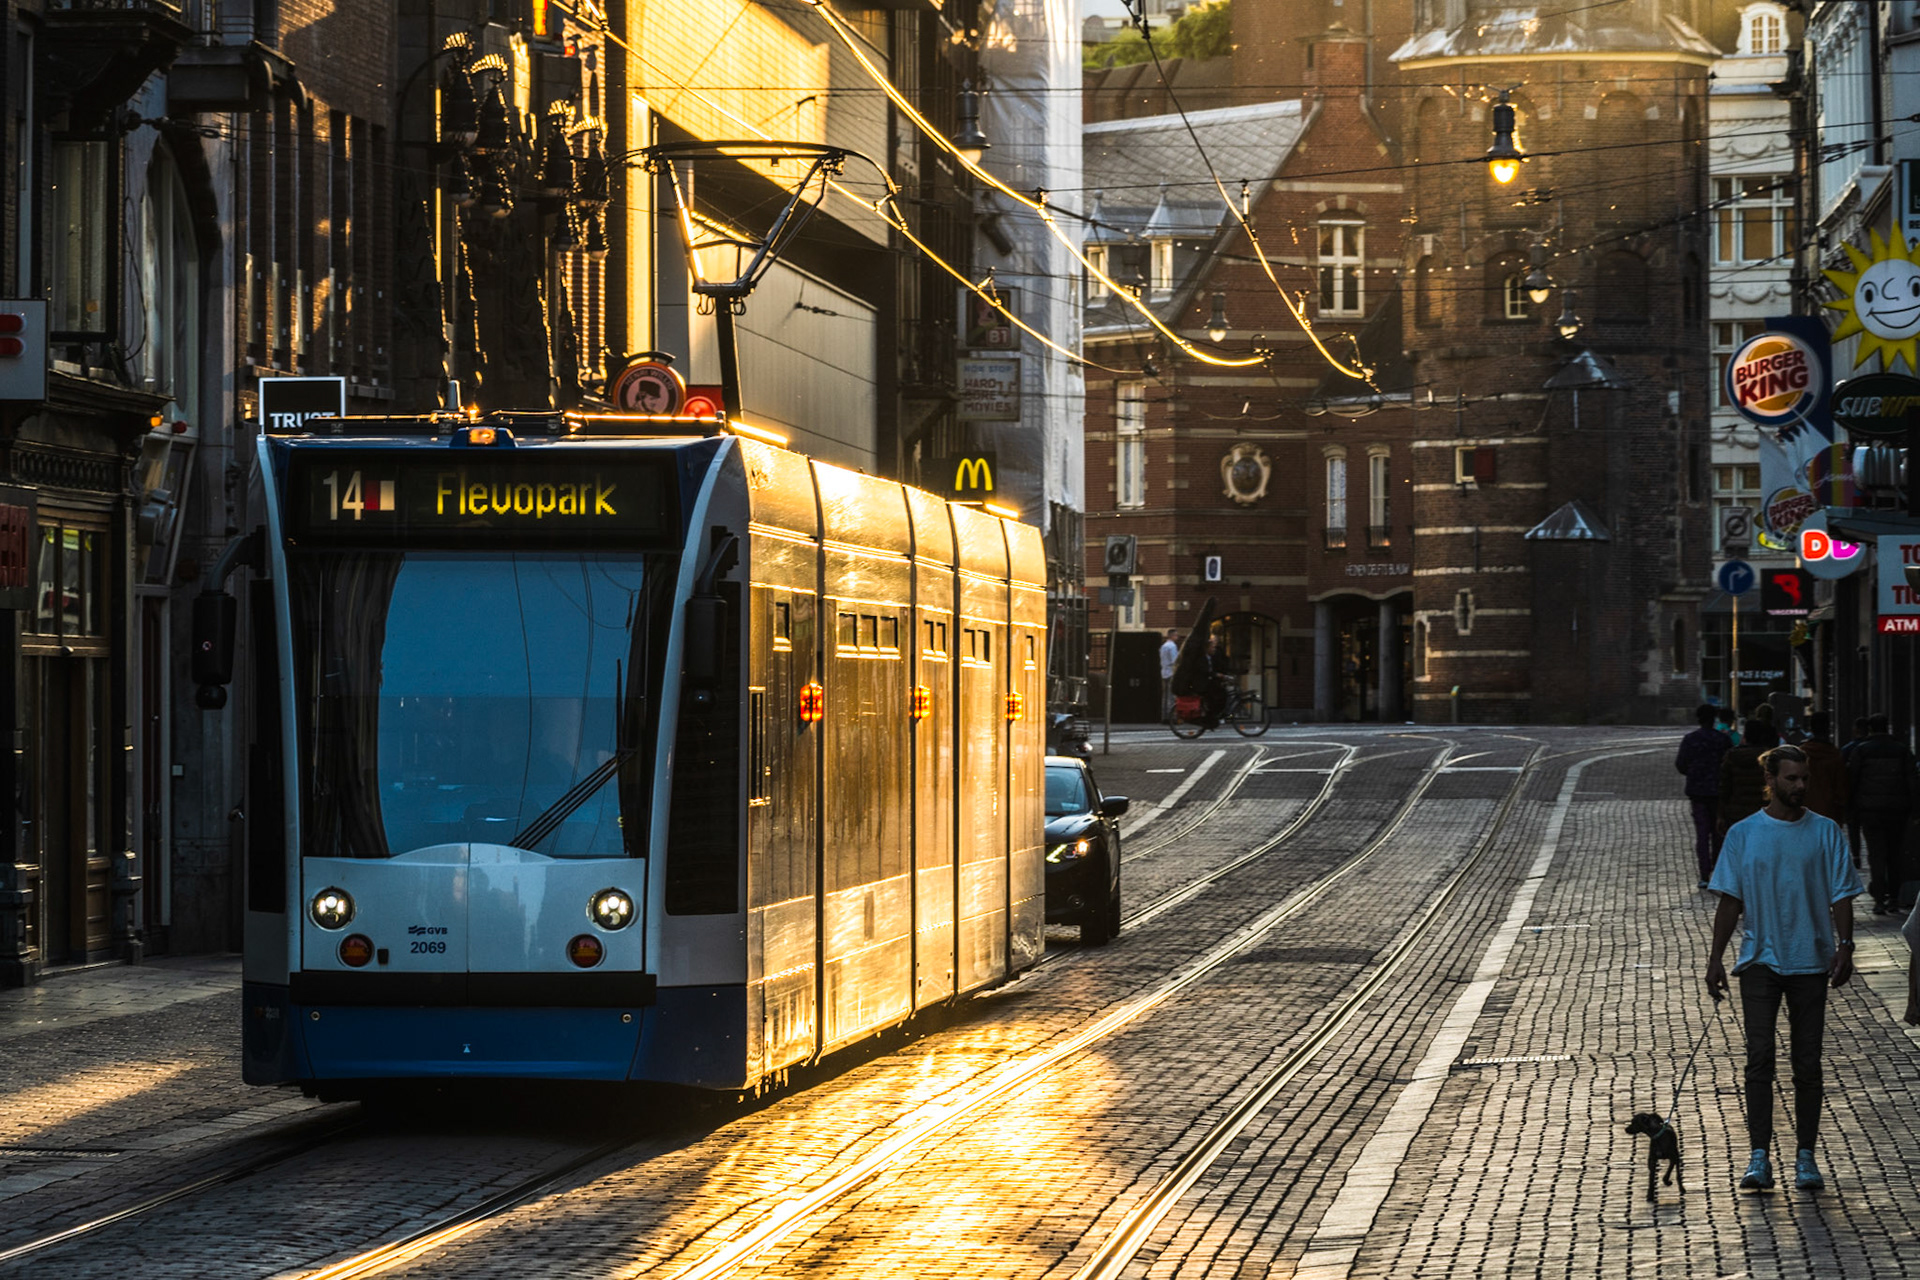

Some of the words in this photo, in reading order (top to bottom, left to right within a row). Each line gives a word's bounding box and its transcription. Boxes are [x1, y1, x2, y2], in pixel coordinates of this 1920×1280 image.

[1736, 350, 1804, 385] BURGER
[964, 379, 996, 388] HARD
[1739, 366, 1808, 408] KING
[964, 402, 1012, 412] MOVIES
[323, 470, 365, 520] 14
[437, 471, 618, 519] Flevopark
[1884, 619, 1918, 631] ATM
[427, 927, 448, 935] GVB
[410, 941, 446, 954] 2069
